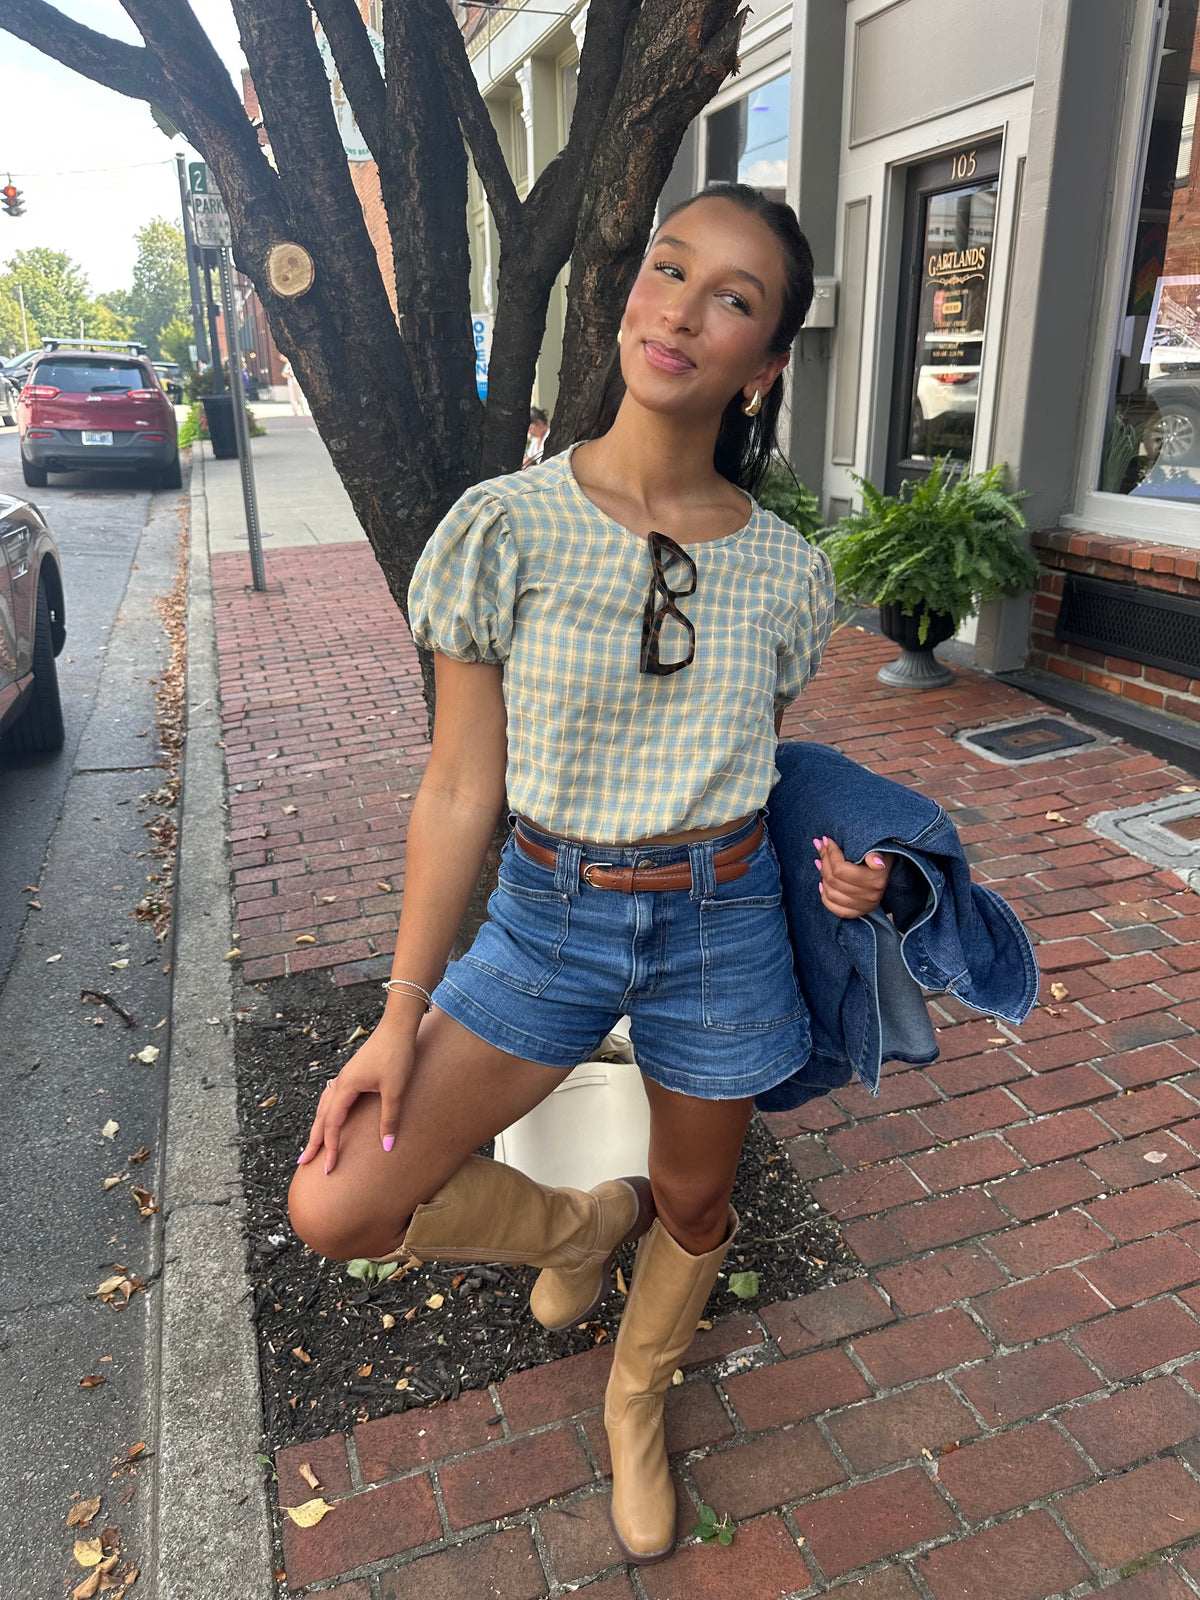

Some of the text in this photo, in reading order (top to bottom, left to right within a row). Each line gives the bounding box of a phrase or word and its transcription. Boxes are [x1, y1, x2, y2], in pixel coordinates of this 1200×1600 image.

[951, 150, 977, 180] 105
[194, 170, 204, 191] 2
[928, 247, 986, 277] GARTLANDS
[473, 321, 487, 375] OPEN
